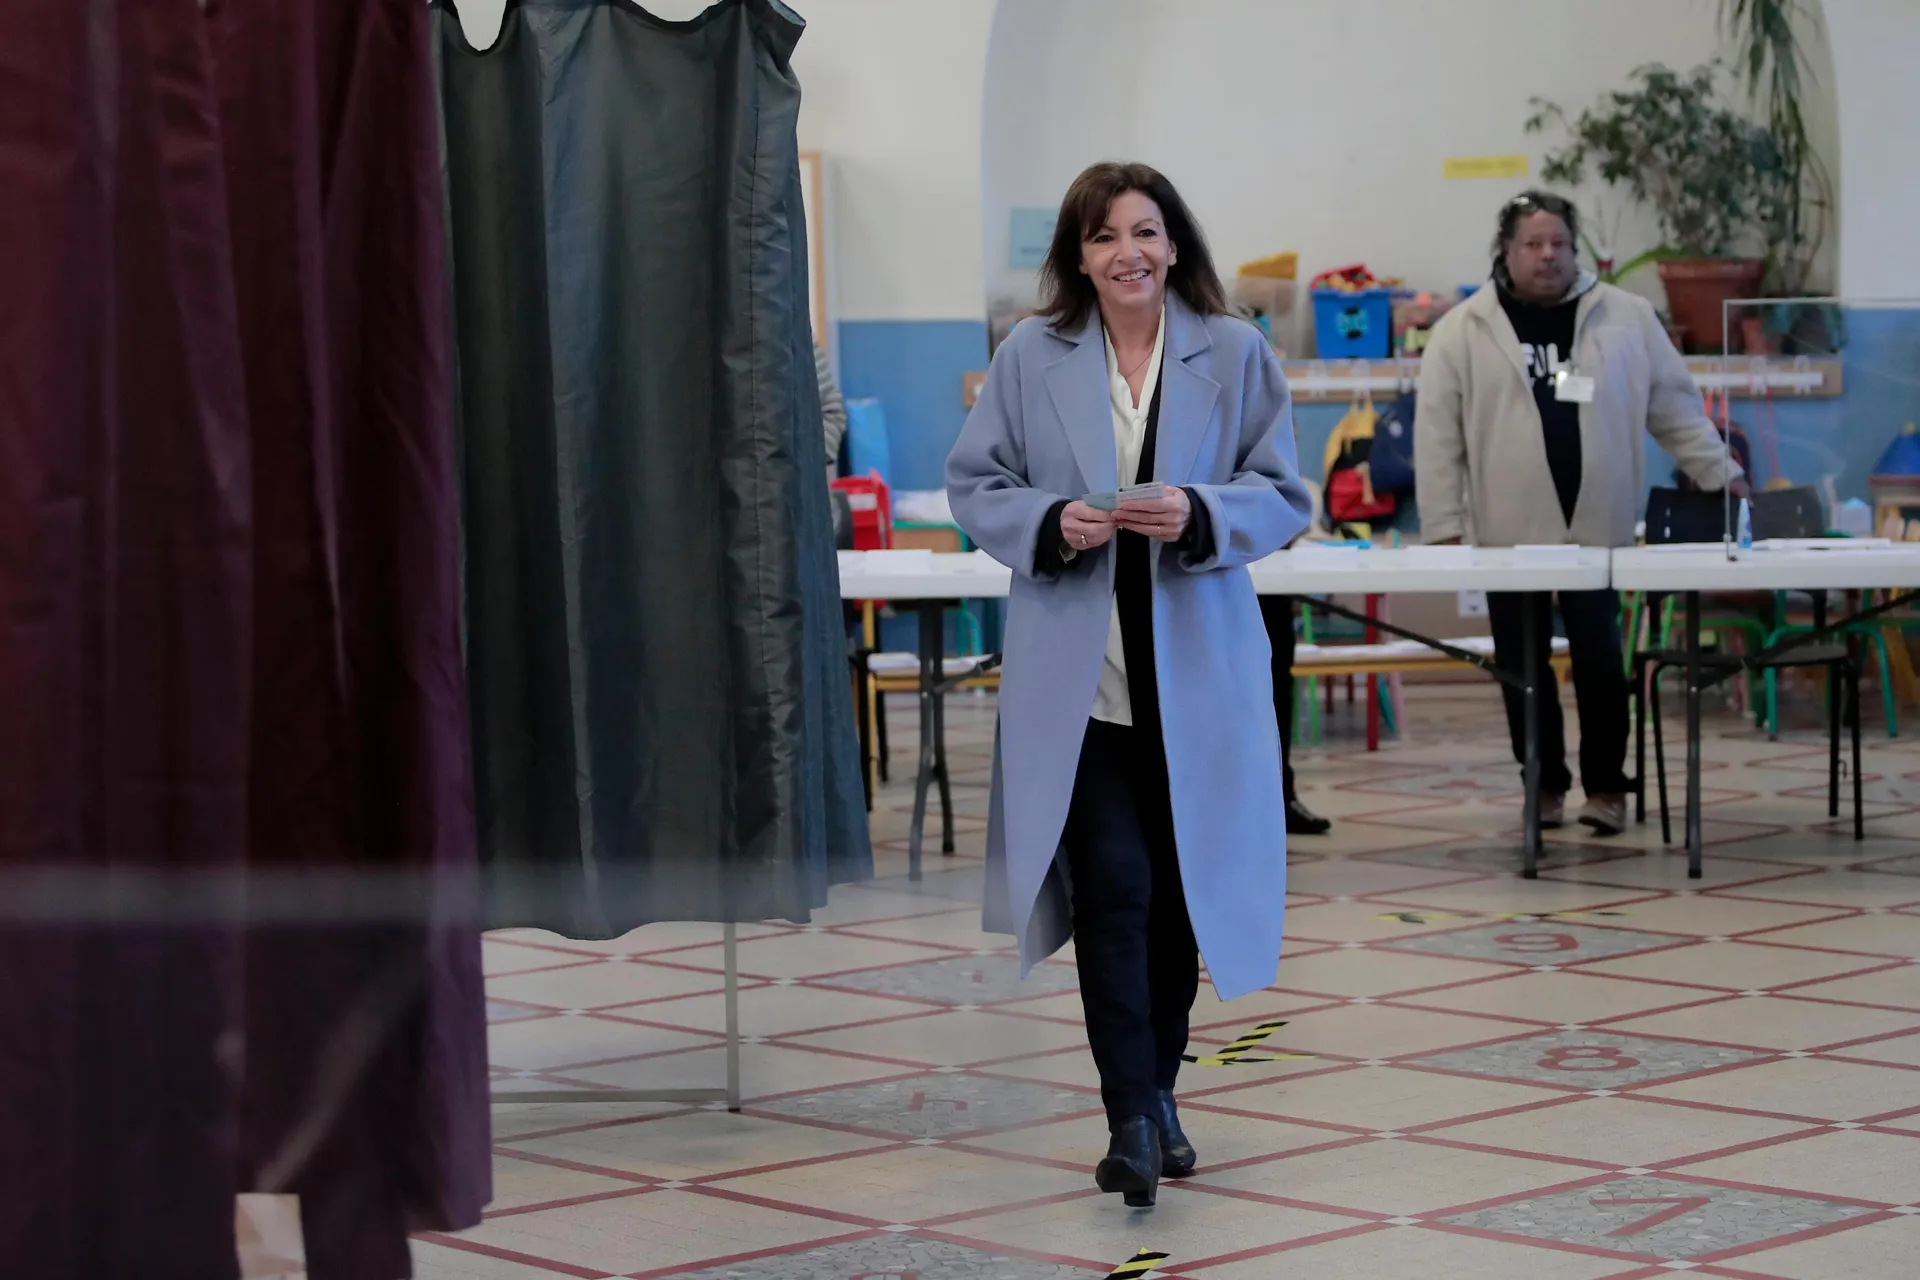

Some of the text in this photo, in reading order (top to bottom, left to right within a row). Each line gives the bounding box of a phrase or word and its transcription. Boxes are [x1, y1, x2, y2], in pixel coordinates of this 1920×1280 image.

[1494, 932, 1579, 953] 9
[1536, 1045, 1641, 1072] 8
[1588, 1196, 1711, 1238] 7
